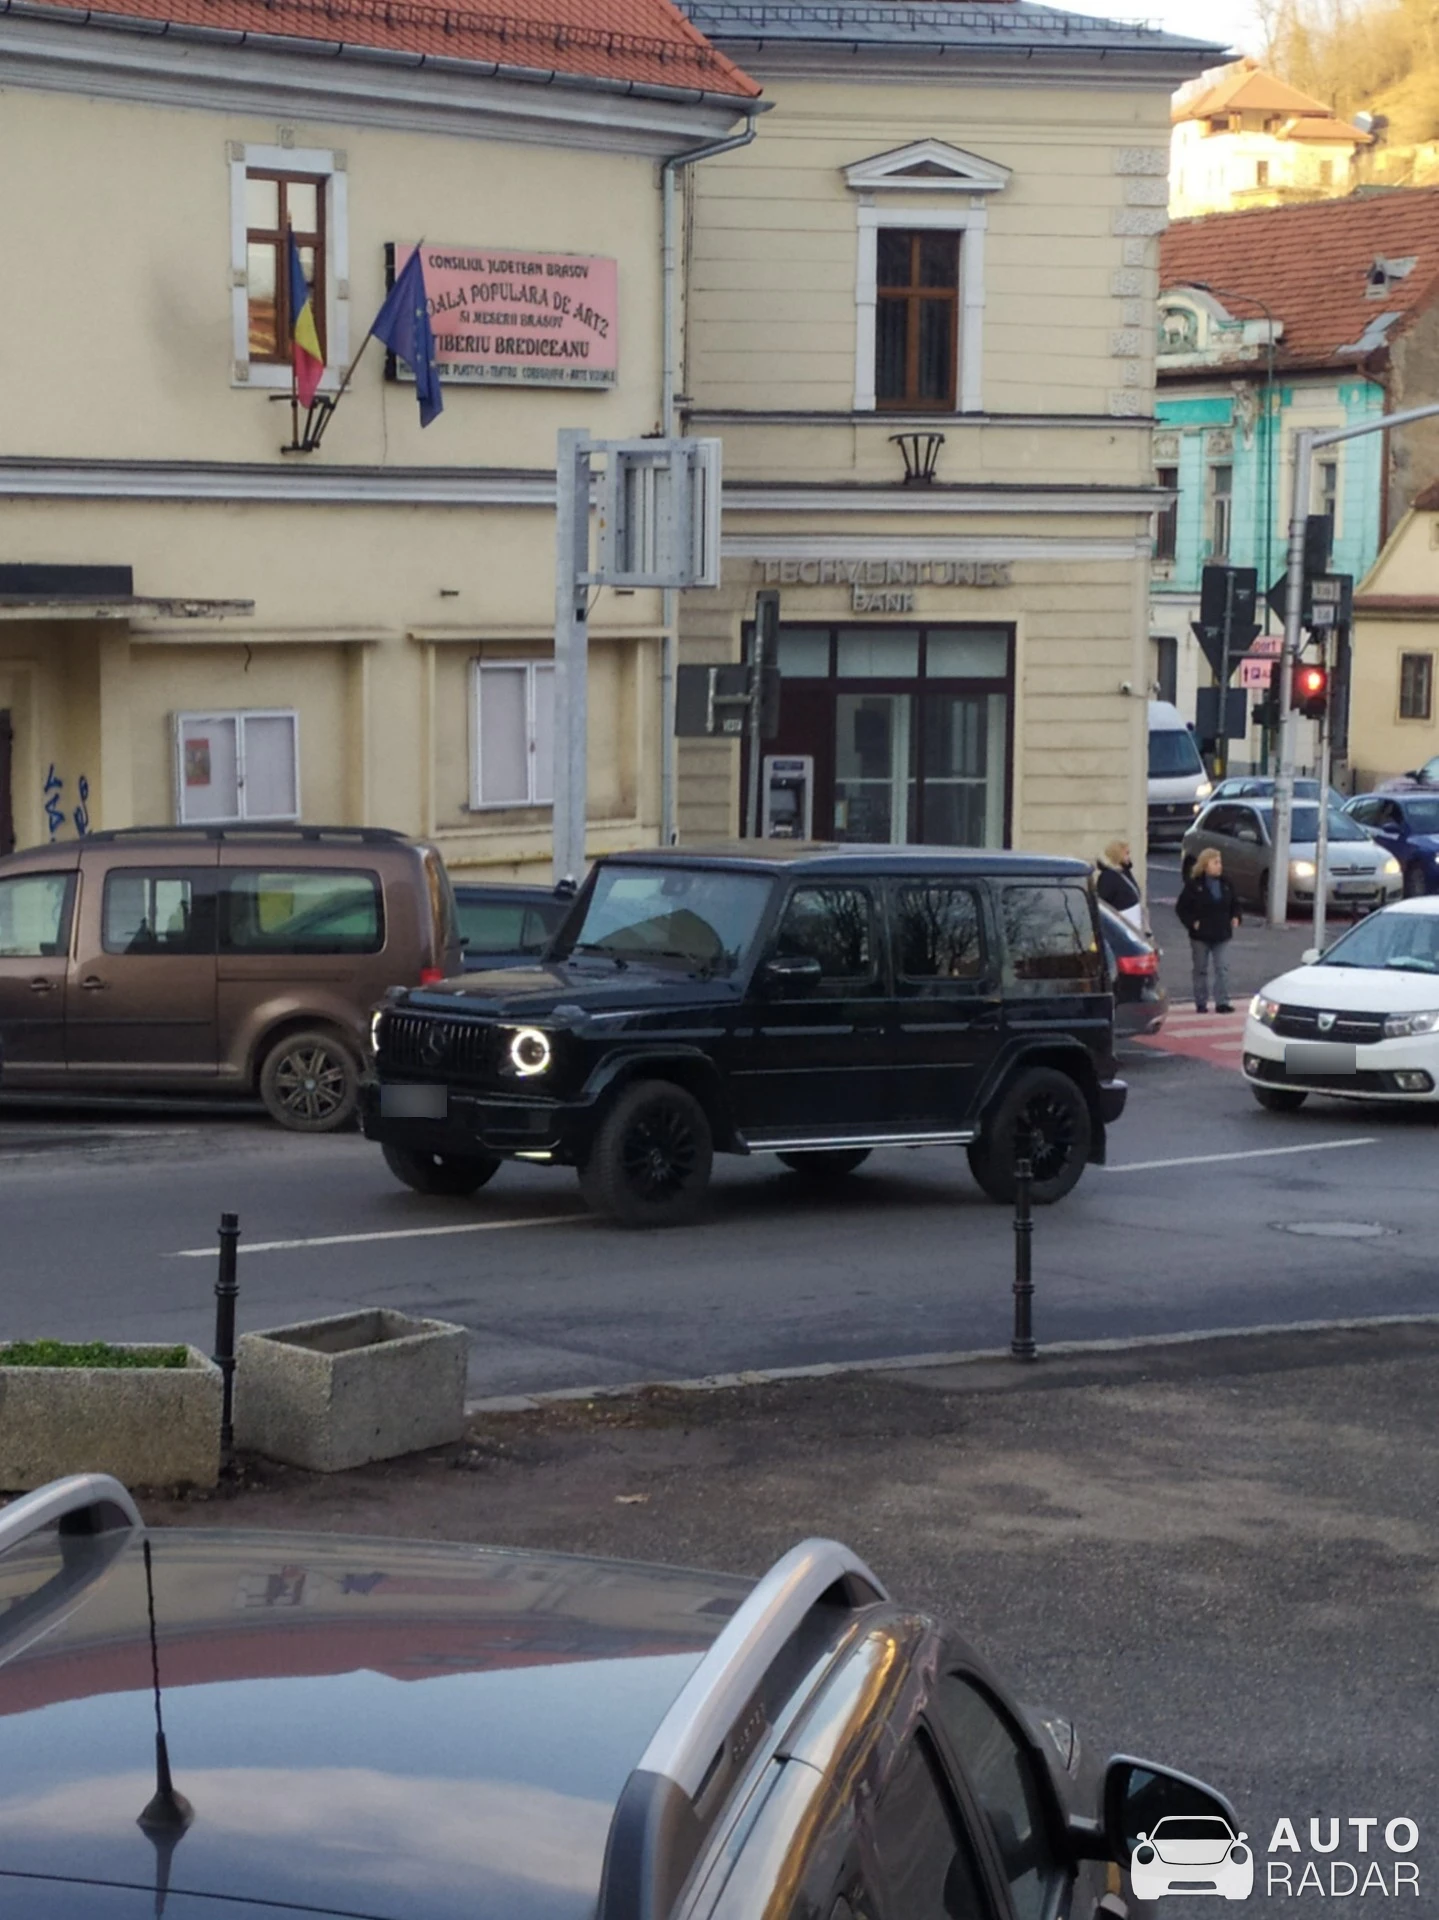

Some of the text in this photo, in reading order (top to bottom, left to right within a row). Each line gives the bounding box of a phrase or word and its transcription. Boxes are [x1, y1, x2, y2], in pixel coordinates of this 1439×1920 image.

[429, 255, 589, 279] CONSILIUL JUDETEAN BRASOV
[471, 282, 548, 307] POPULARA
[552, 291, 571, 315] DE
[495, 337, 589, 358] BREDICEANU
[755, 559, 1011, 586] TECHVENTURES
[852, 590, 914, 612] BANK
